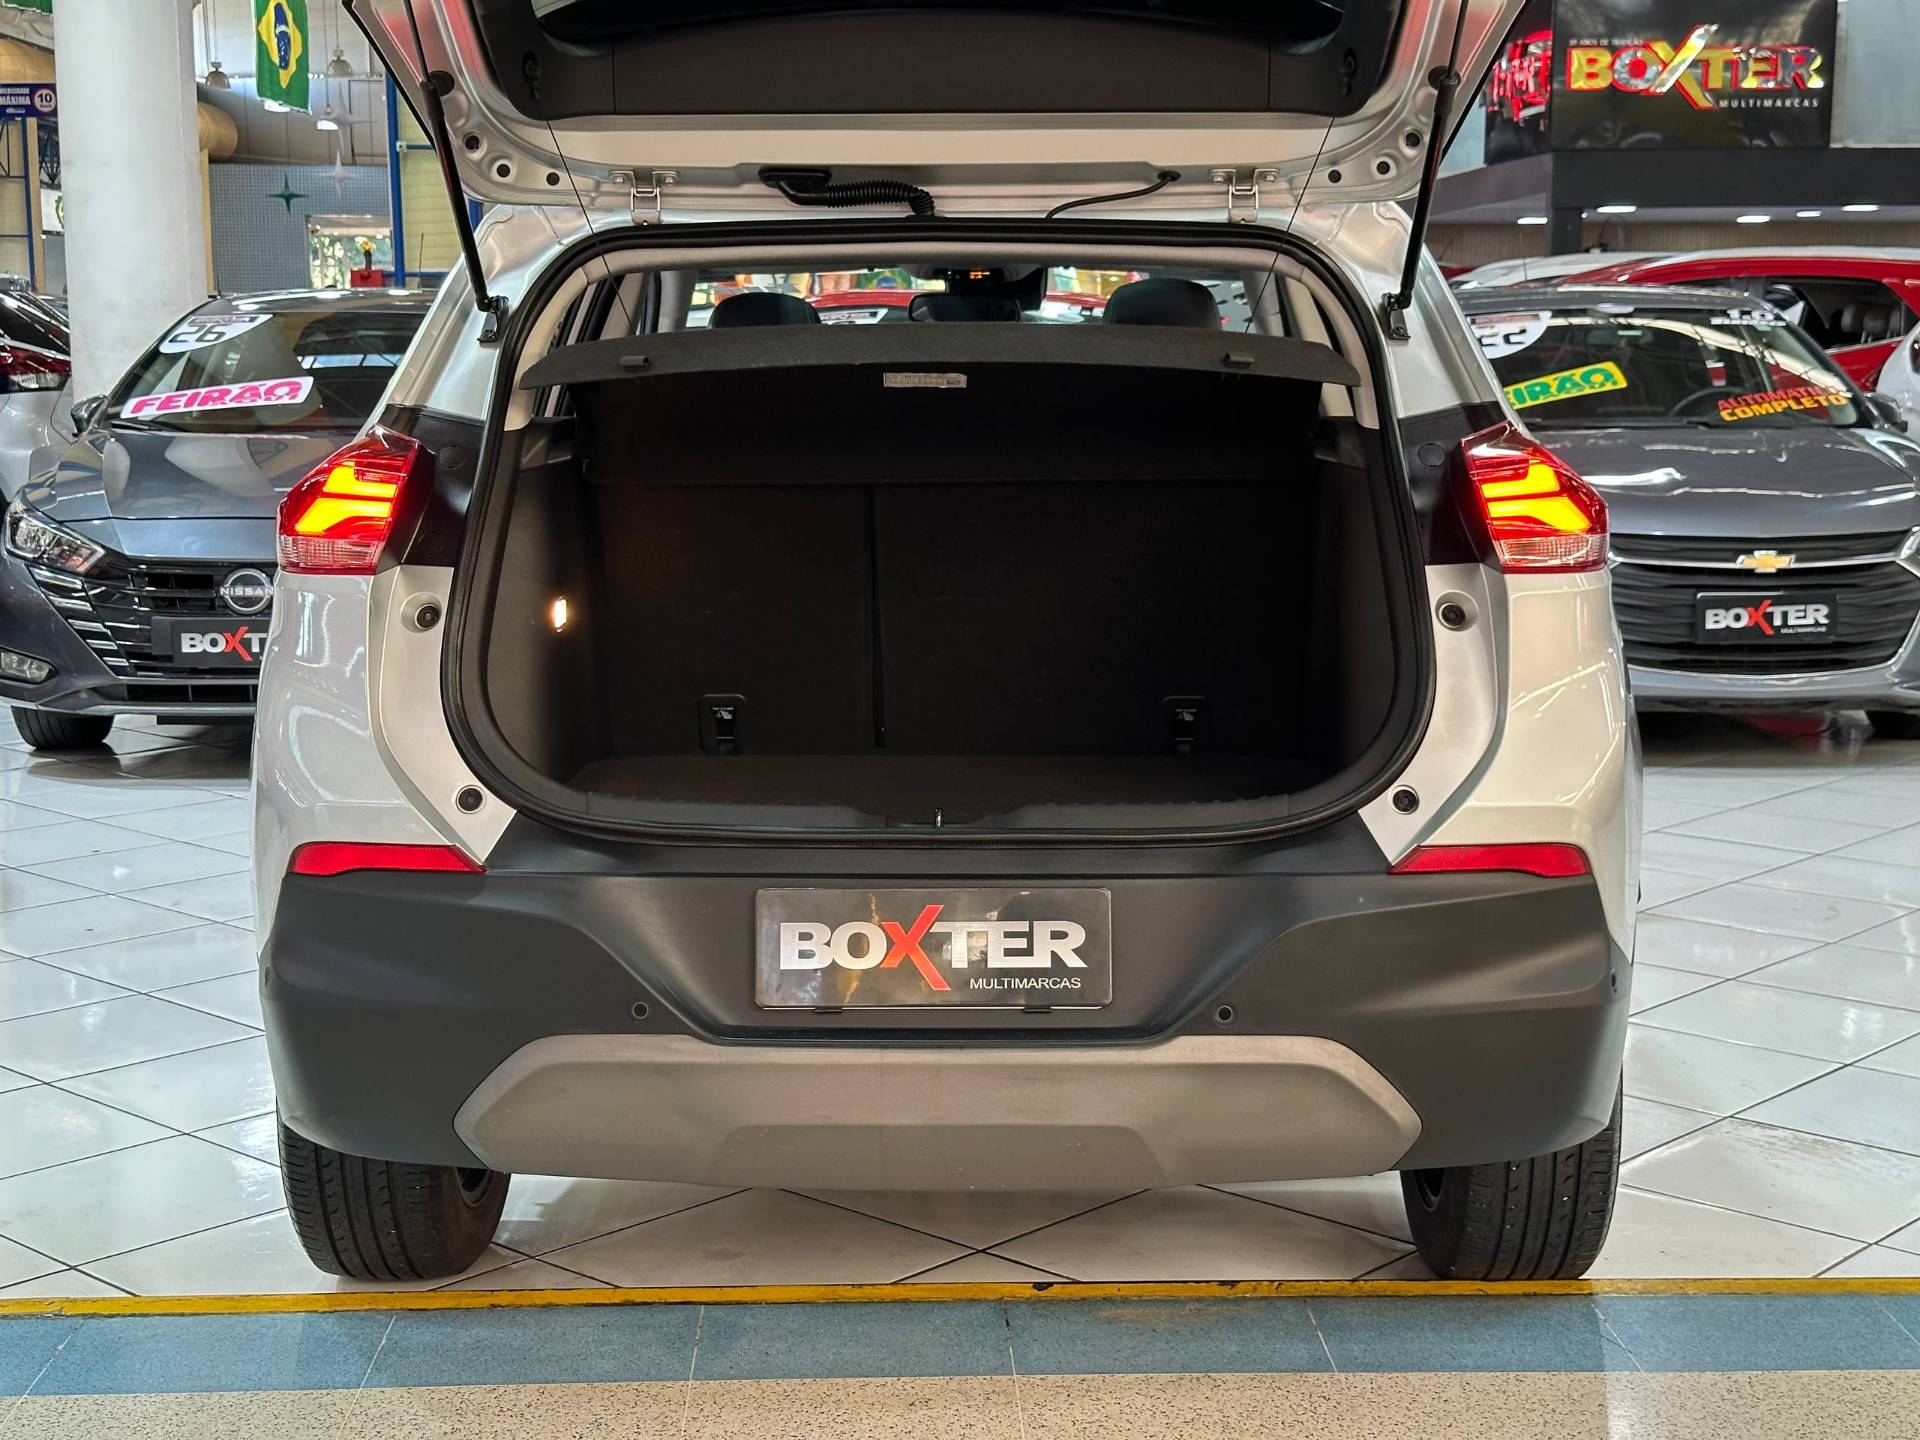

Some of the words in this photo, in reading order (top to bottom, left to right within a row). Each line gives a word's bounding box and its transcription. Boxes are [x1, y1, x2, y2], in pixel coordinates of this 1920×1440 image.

[1566, 24, 1826, 110] BOXTER
[38, 92, 53, 103] 10
[1719, 97, 1820, 109] MULTIMARCAS
[168, 323, 227, 343] 26
[130, 381, 303, 415] FEIRÃO
[1720, 394, 1848, 421] COMPLETO
[220, 587, 273, 596] NISSAN
[1705, 600, 1830, 635] BOXTER
[779, 904, 1088, 991] BOXTER
[969, 976, 1081, 990] MULTIMARCAS
